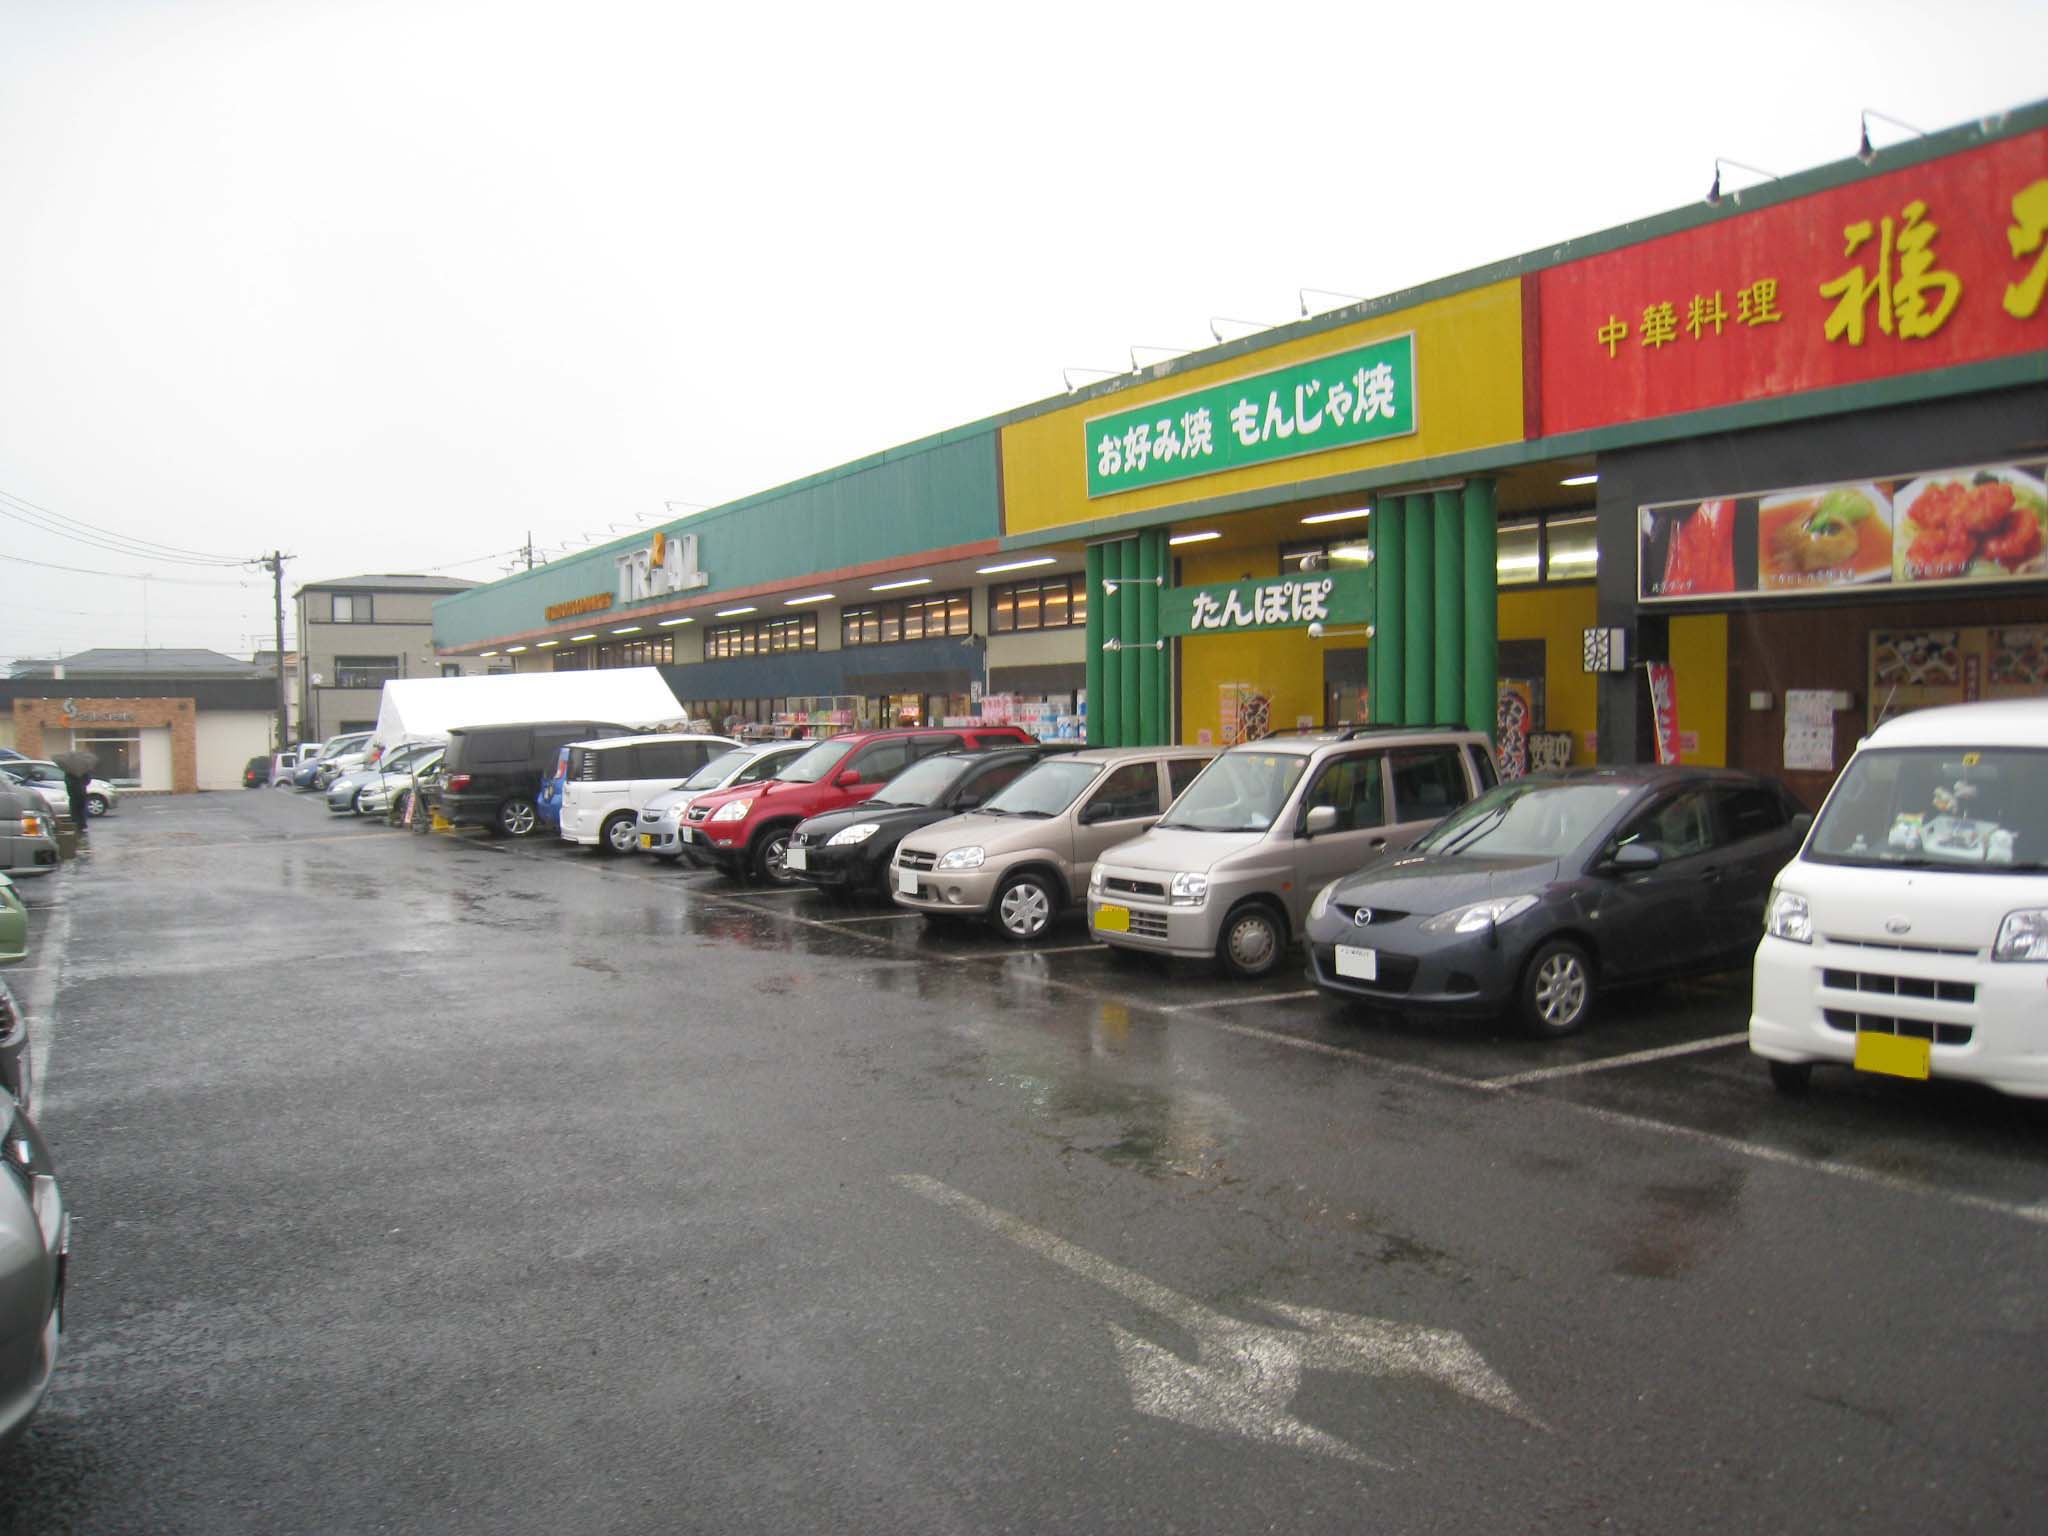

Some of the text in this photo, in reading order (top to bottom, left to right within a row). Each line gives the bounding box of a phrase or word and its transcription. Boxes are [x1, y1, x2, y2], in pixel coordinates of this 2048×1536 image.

[1598, 279, 1783, 359] 中華料理
[1098, 363, 1395, 477] お好み焼 もんじゃ焼
[614, 532, 709, 604] TRIAL
[1192, 579, 1333, 630] たんぽぽ
